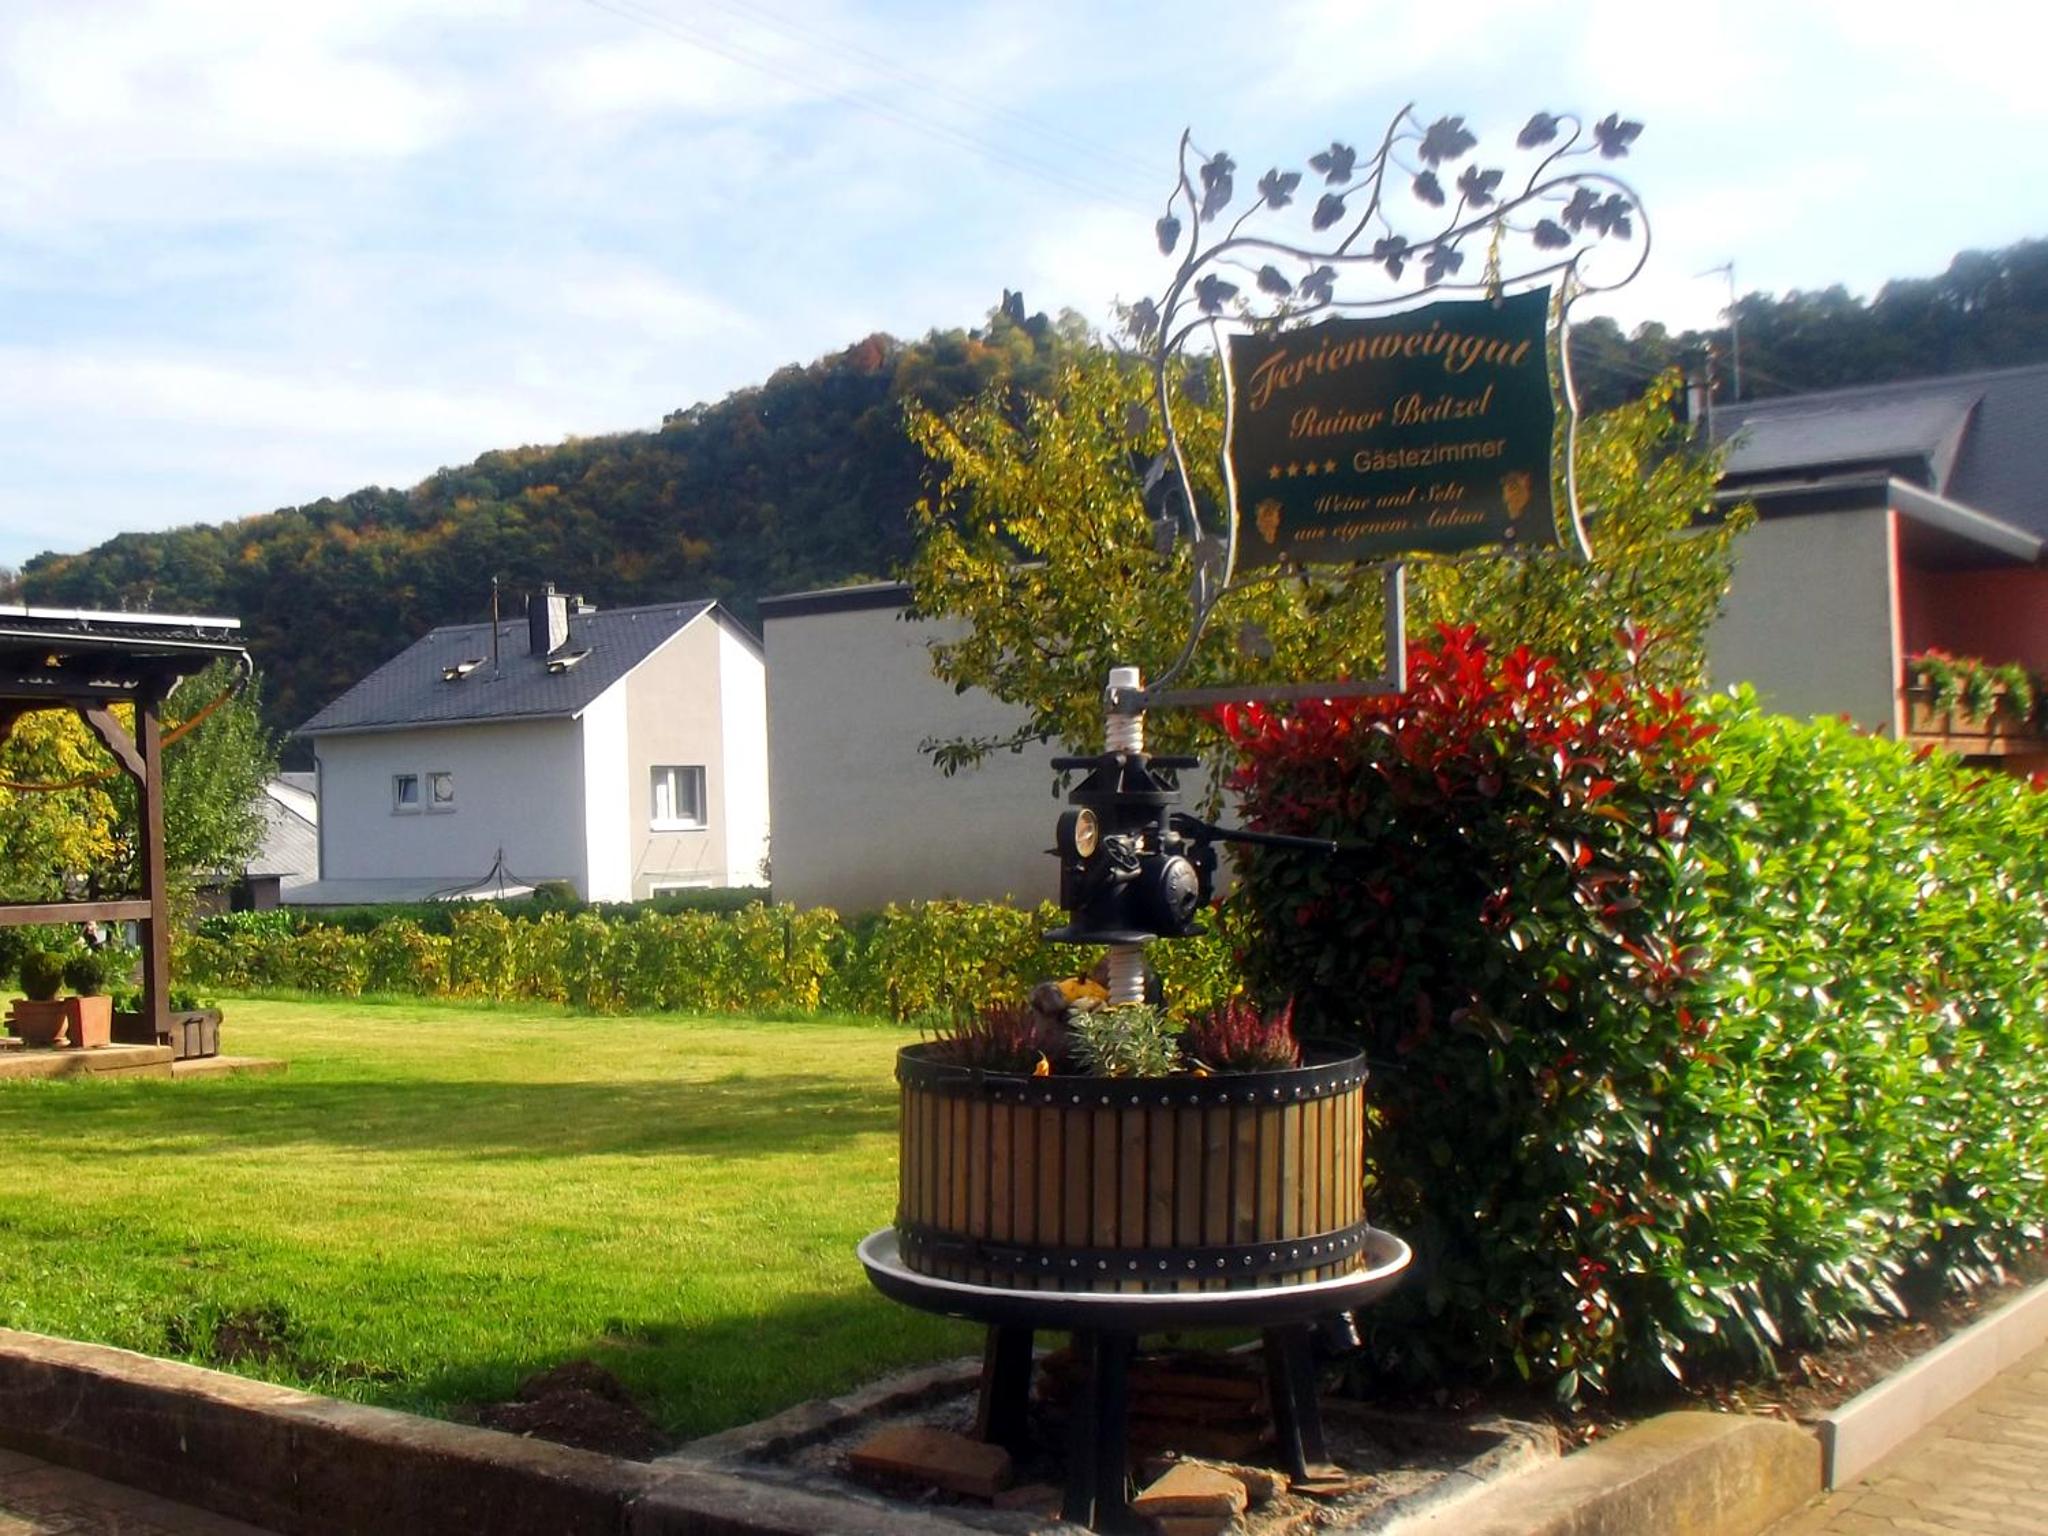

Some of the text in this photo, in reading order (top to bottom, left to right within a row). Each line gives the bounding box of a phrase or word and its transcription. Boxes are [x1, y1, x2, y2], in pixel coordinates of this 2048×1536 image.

[1249, 320, 1532, 411] Ferienweingut
[1289, 406, 1384, 439] Rainer
[1352, 438, 1507, 473] Gästezimmer
